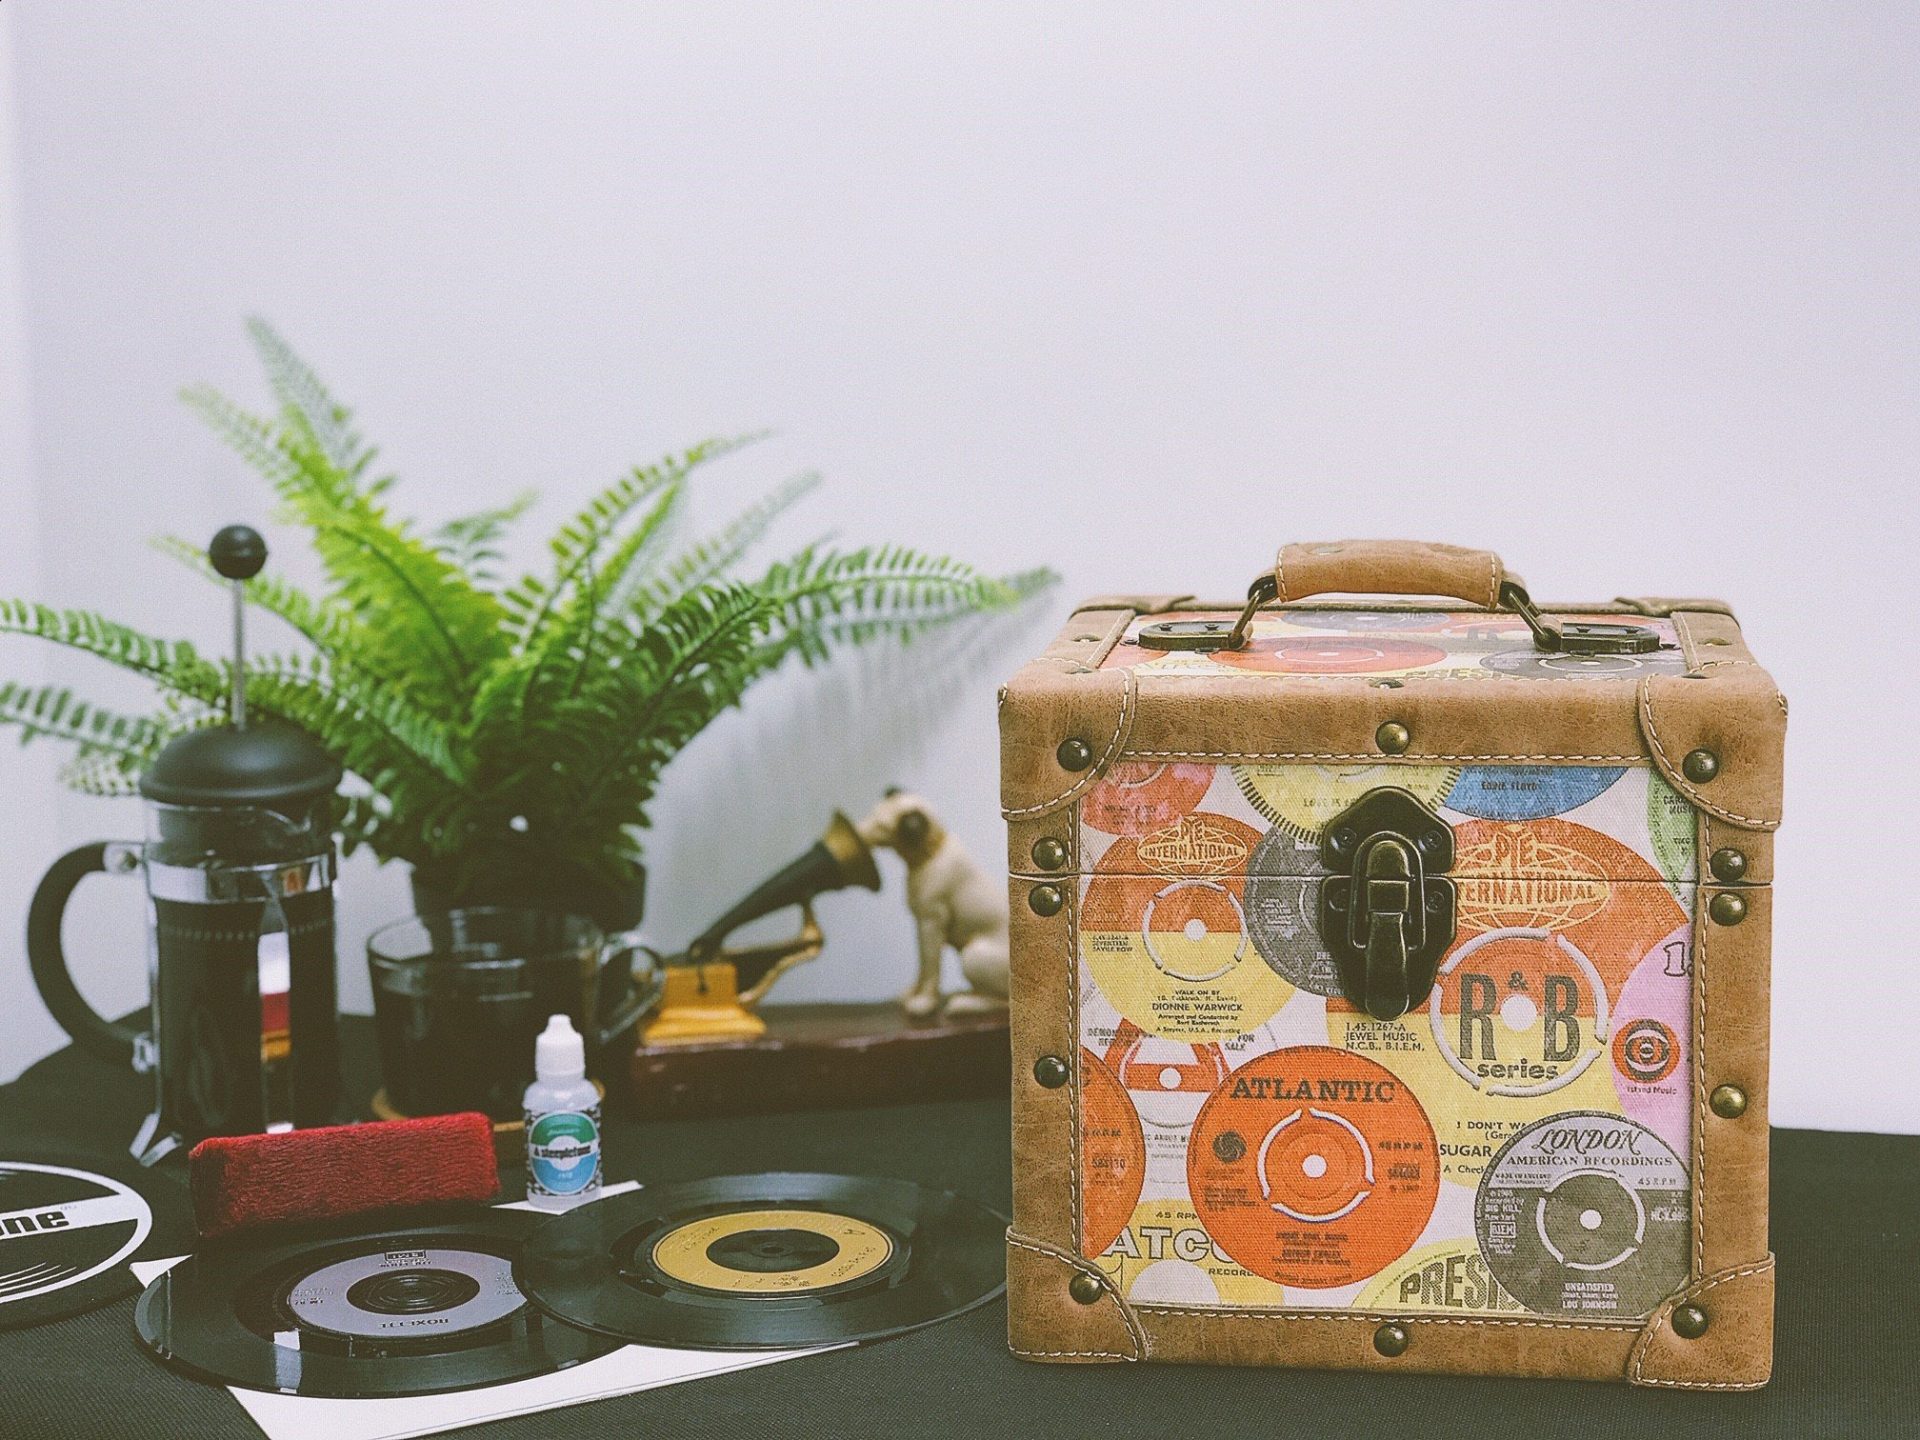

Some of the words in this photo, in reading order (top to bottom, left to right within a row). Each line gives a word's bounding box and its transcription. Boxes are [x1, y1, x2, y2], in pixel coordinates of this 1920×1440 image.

[1144, 842, 1239, 861] INTERNATIONAL
[1459, 880, 1597, 904] ERNATIONAL
[1152, 1002, 1191, 1011] DIONNE
[1194, 1002, 1244, 1012] WARWICK
[1460, 973, 1496, 1061] R
[1508, 971, 1528, 990] &
[1544, 974, 1581, 1062] B
[1346, 1022, 1406, 1032] 1.45.1267-A
[1345, 1032, 1379, 1042] JEWEL
[1382, 1032, 1418, 1042] MUSIC
[1477, 1058, 1558, 1080] series
[1230, 1076, 1396, 1103] ATLANTIC
[1467, 1121, 1503, 1130] DON'T
[1531, 1129, 1643, 1155] LONDON
[1439, 1144, 1492, 1158] SUGAR
[1506, 1155, 1578, 1167] AMERICAN
[1584, 1156, 1673, 1167] RECORDINGS
[1443, 1165, 1452, 1174] A
[0, 1210, 70, 1237] ne
